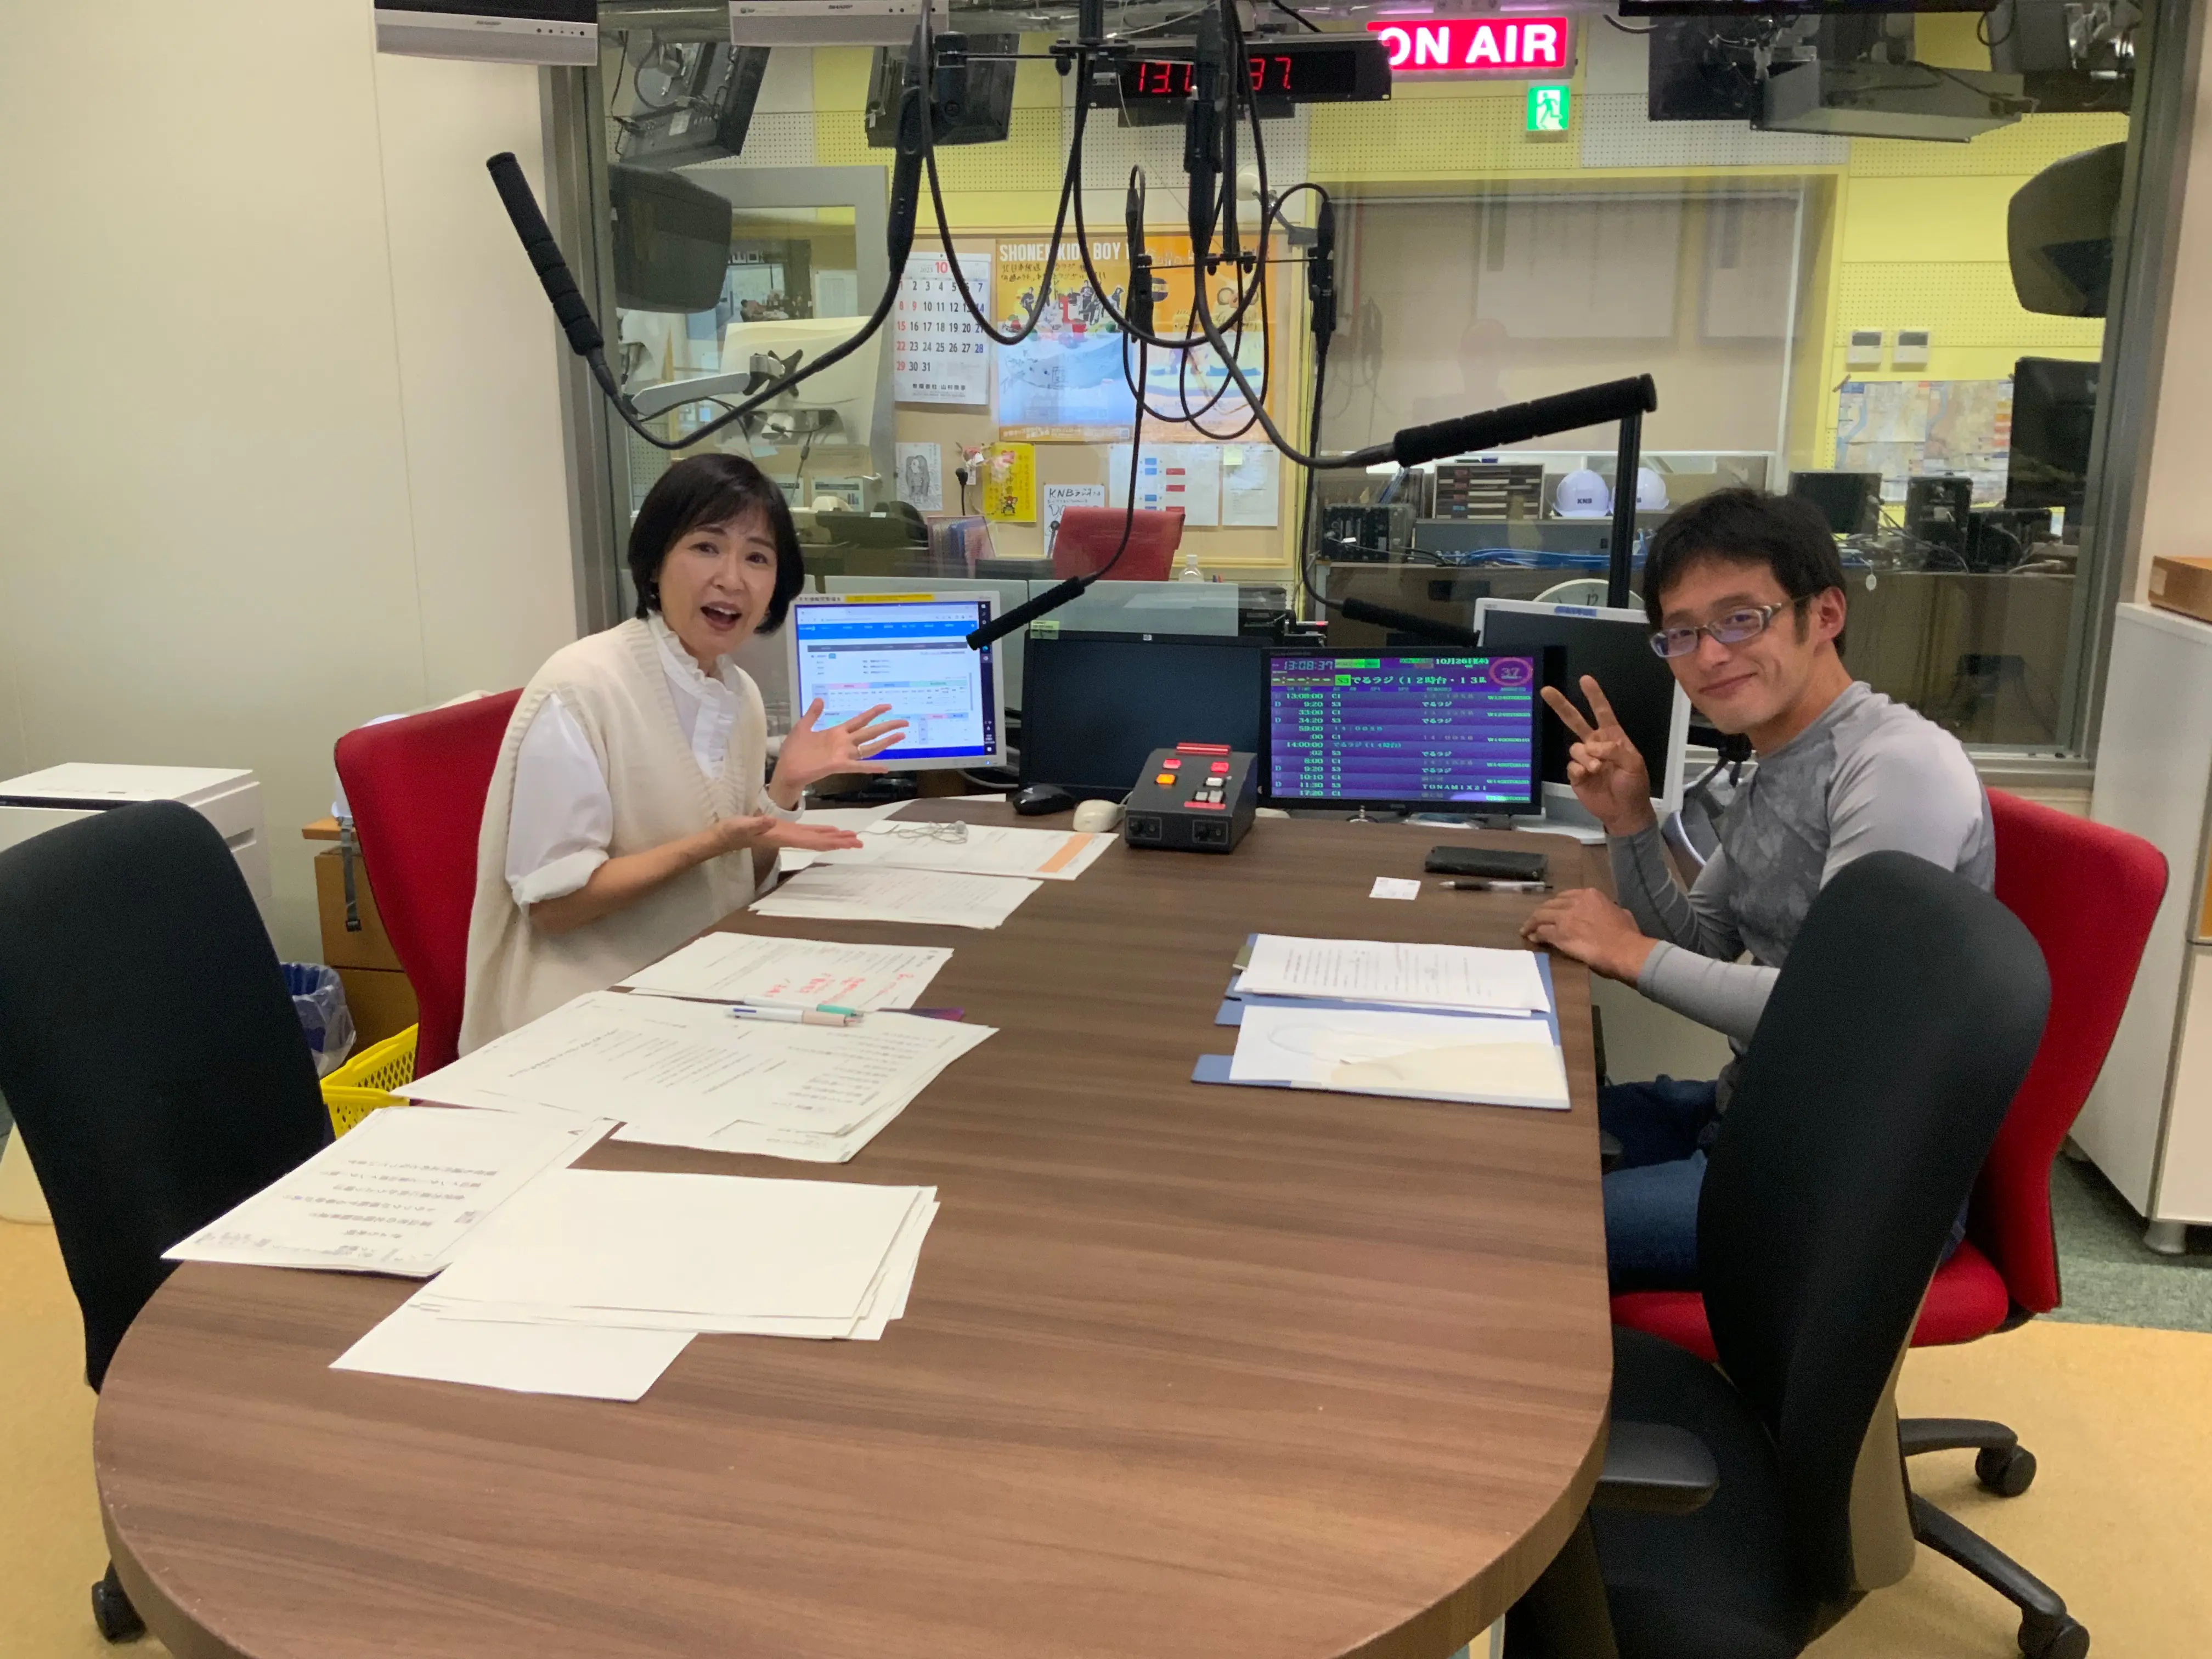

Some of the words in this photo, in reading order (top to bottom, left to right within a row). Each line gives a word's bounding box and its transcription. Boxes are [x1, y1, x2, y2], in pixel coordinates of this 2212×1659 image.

[1378, 26, 1450, 65] ON
[1465, 24, 1557, 63] AIR
[1093, 242, 1121, 260] BOY
[935, 262, 949, 274] 10
[912, 281, 917, 291] 2
[926, 281, 930, 291] 3
[939, 281, 943, 291] 4
[952, 282, 957, 291] 5
[978, 283, 983, 292] 7
[912, 302, 917, 311] 9
[924, 302, 932, 312] 10
[936, 302, 945, 312] 11
[950, 302, 958, 312] 12
[898, 320, 906, 331] 15
[910, 321, 919, 331] 16
[923, 322, 932, 332] 17
[936, 322, 945, 332] 18
[950, 323, 958, 332] 19
[962, 323, 971, 333] 20
[896, 341, 905, 351] 22
[910, 341, 918, 352] 23
[923, 342, 932, 352] 24
[936, 342, 945, 352] 25
[949, 343, 958, 353] 26
[962, 343, 970, 353] 27
[975, 343, 984, 353] 28
[896, 361, 905, 371] 29
[909, 362, 918, 371] 30
[922, 362, 931, 371] 31
[1284, 660, 1333, 670] 13:08:37
[1501, 667, 1521, 676] 37
